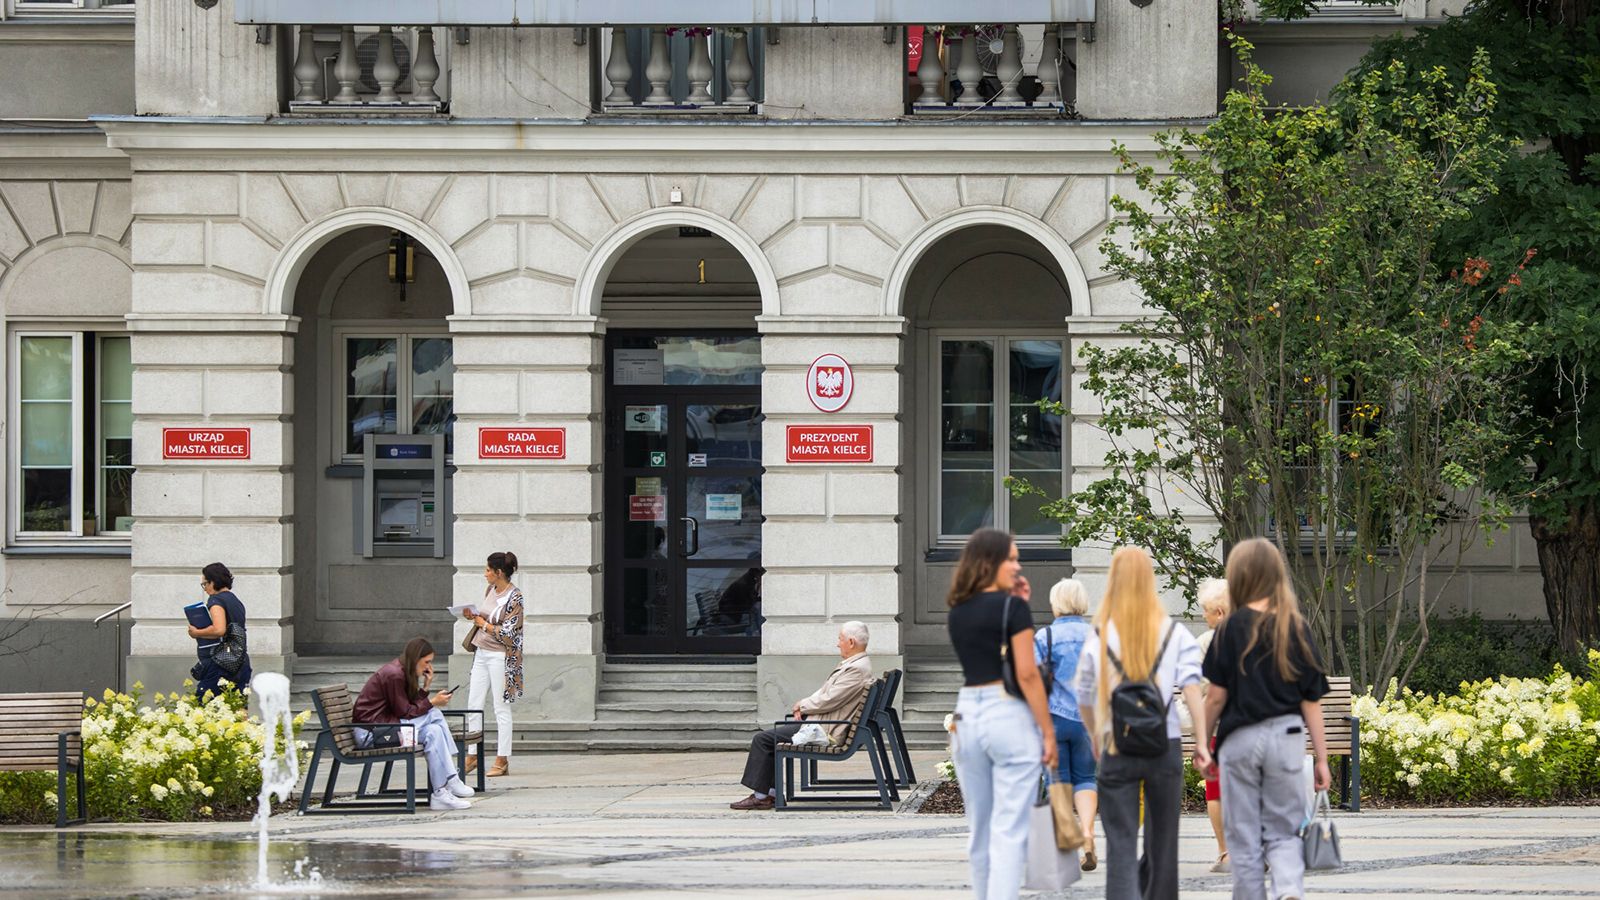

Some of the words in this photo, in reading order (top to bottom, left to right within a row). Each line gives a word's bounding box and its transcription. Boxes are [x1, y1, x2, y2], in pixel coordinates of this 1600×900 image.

[698, 260, 706, 284] 1
[188, 432, 225, 443] URZĄD
[507, 432, 537, 441] RADA
[800, 433, 859, 442] PREZYDENT
[168, 445, 207, 454] MIASTA
[210, 445, 244, 454] KIELCE
[484, 445, 523, 454] MIASTA
[525, 445, 559, 454] KIELCE
[792, 445, 830, 454] MIASTA
[833, 445, 867, 454] KIELCE
